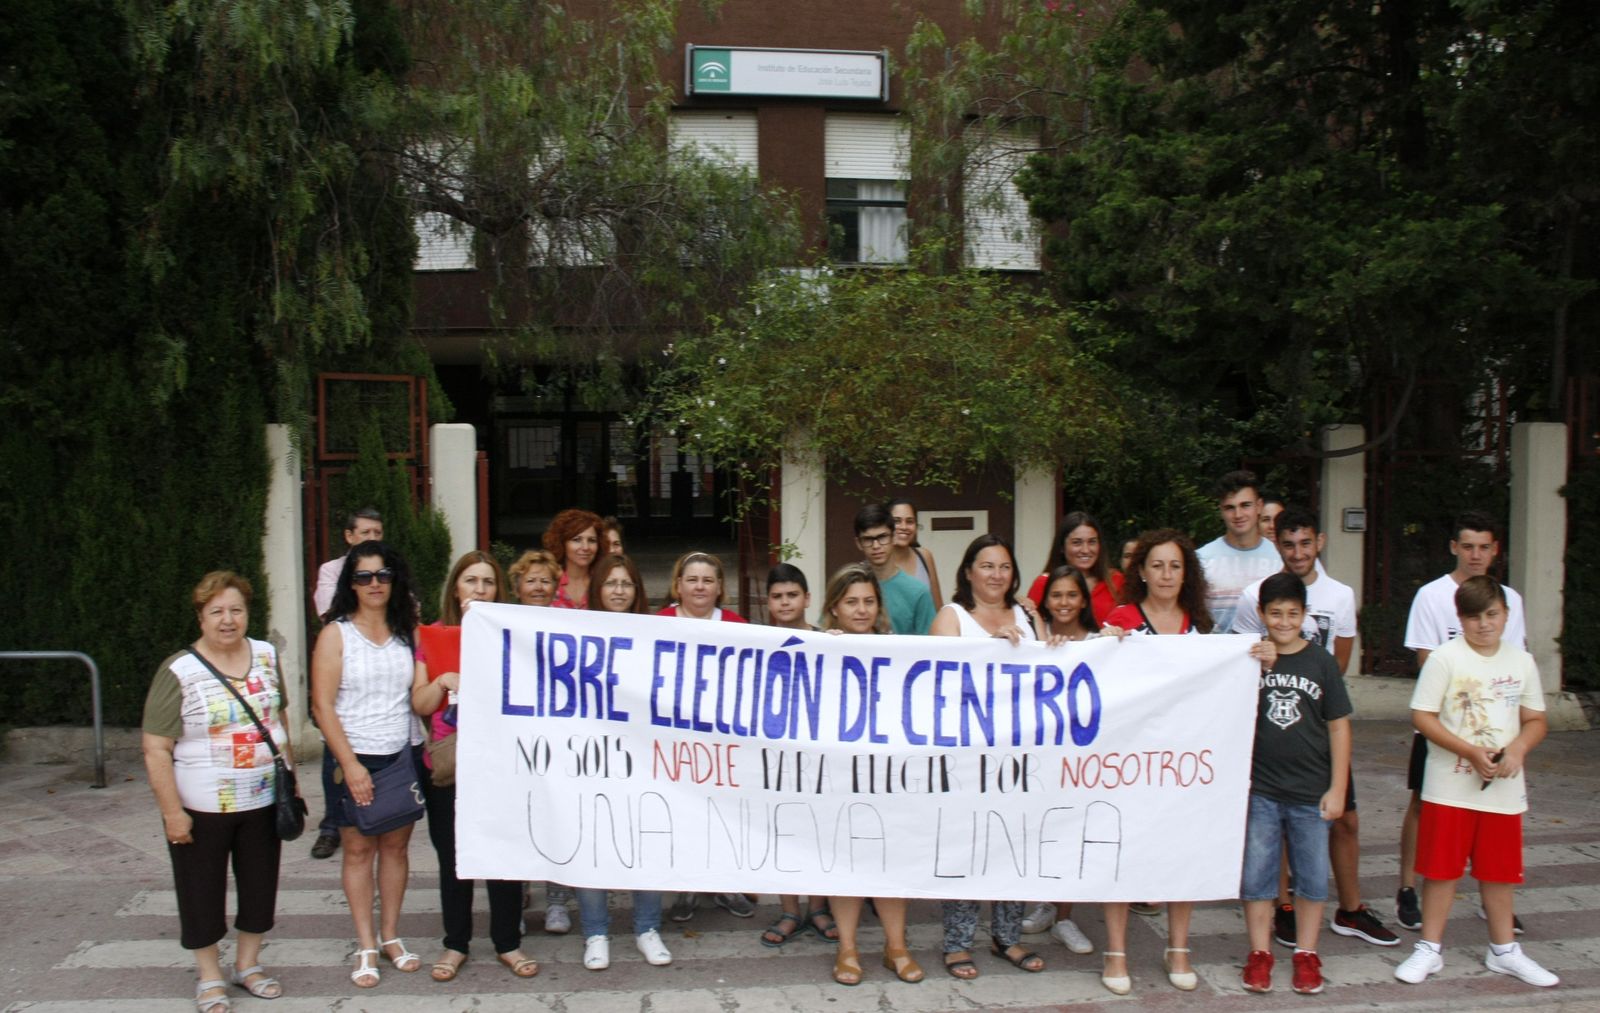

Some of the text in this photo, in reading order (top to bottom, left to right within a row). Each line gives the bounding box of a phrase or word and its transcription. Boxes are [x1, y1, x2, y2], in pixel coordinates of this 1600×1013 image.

[502, 628, 1101, 747] LIBRE ELECCIÓN DE CENTRO
[1258, 673, 1324, 700] OGWARTS
[515, 734, 1214, 795] NO SOIS NADIE PARA ELEGIR POR NOSOTROS
[528, 790, 1122, 882] UNA NUEVA LINEA
